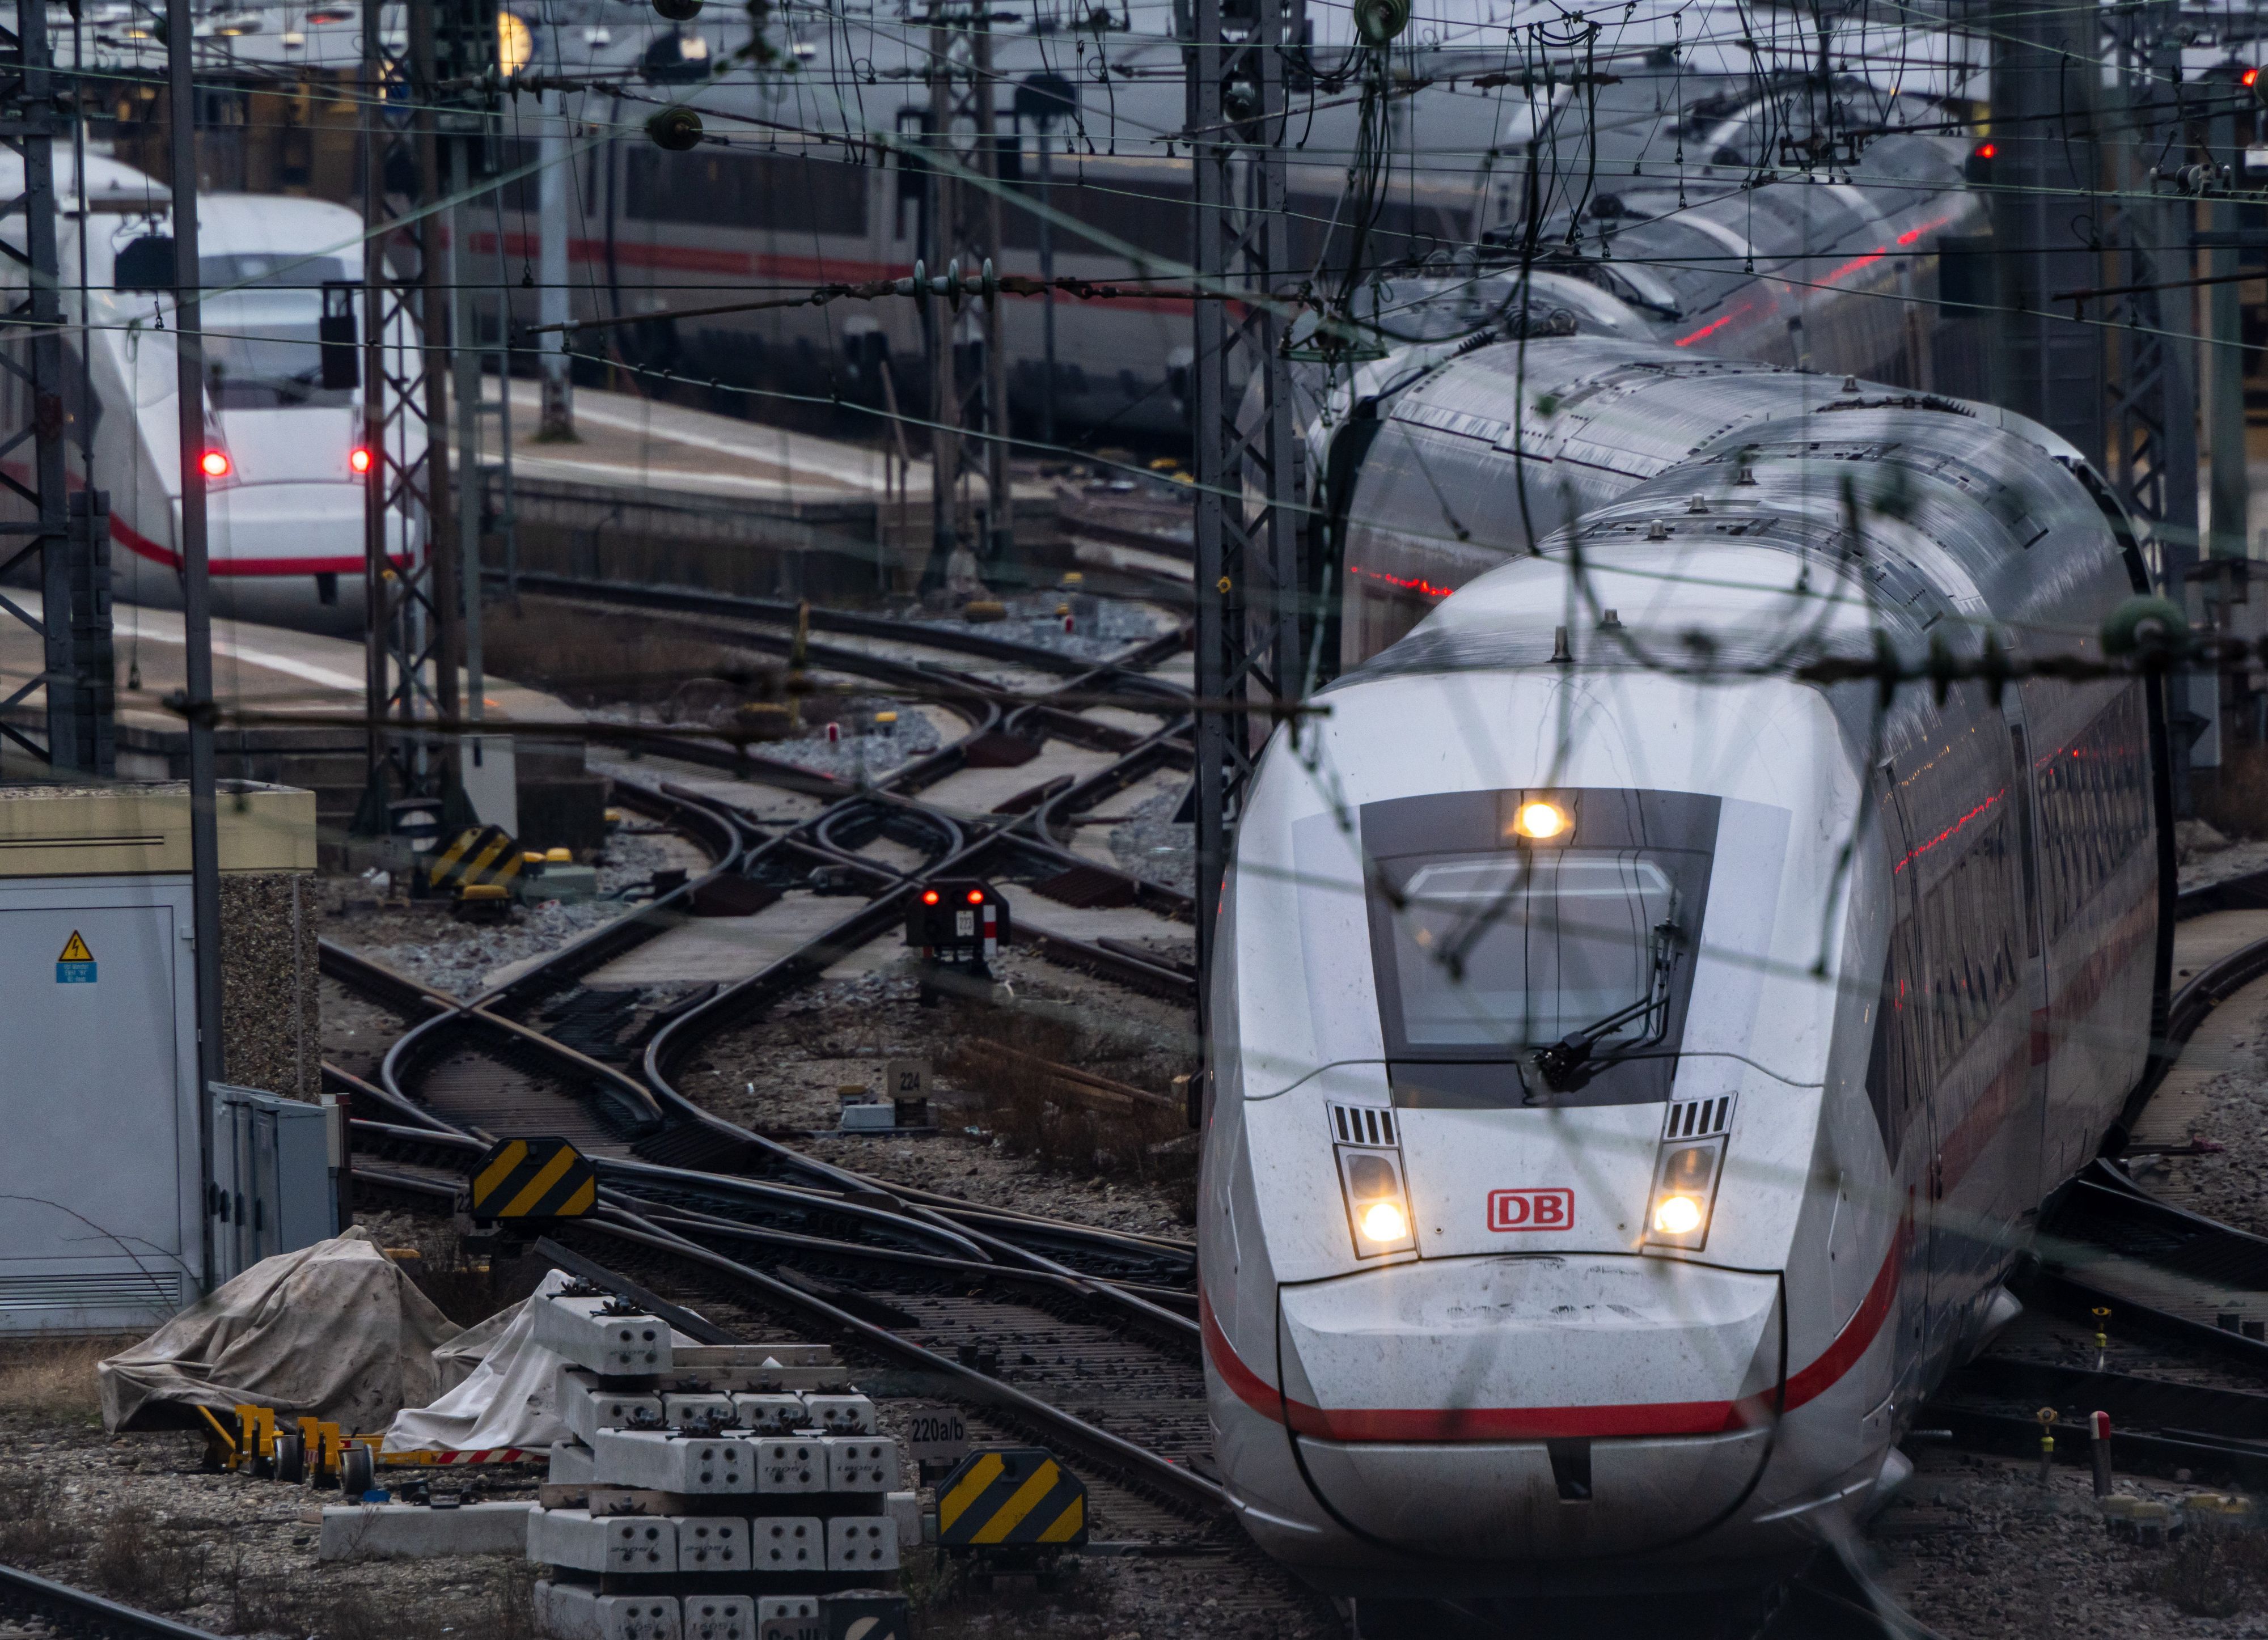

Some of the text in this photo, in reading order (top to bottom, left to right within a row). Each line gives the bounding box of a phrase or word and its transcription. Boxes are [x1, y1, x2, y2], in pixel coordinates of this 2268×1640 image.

[900, 1071, 920, 1091] 224
[1499, 1195, 1564, 1224] DB
[911, 1416, 964, 1442] 220a/b
